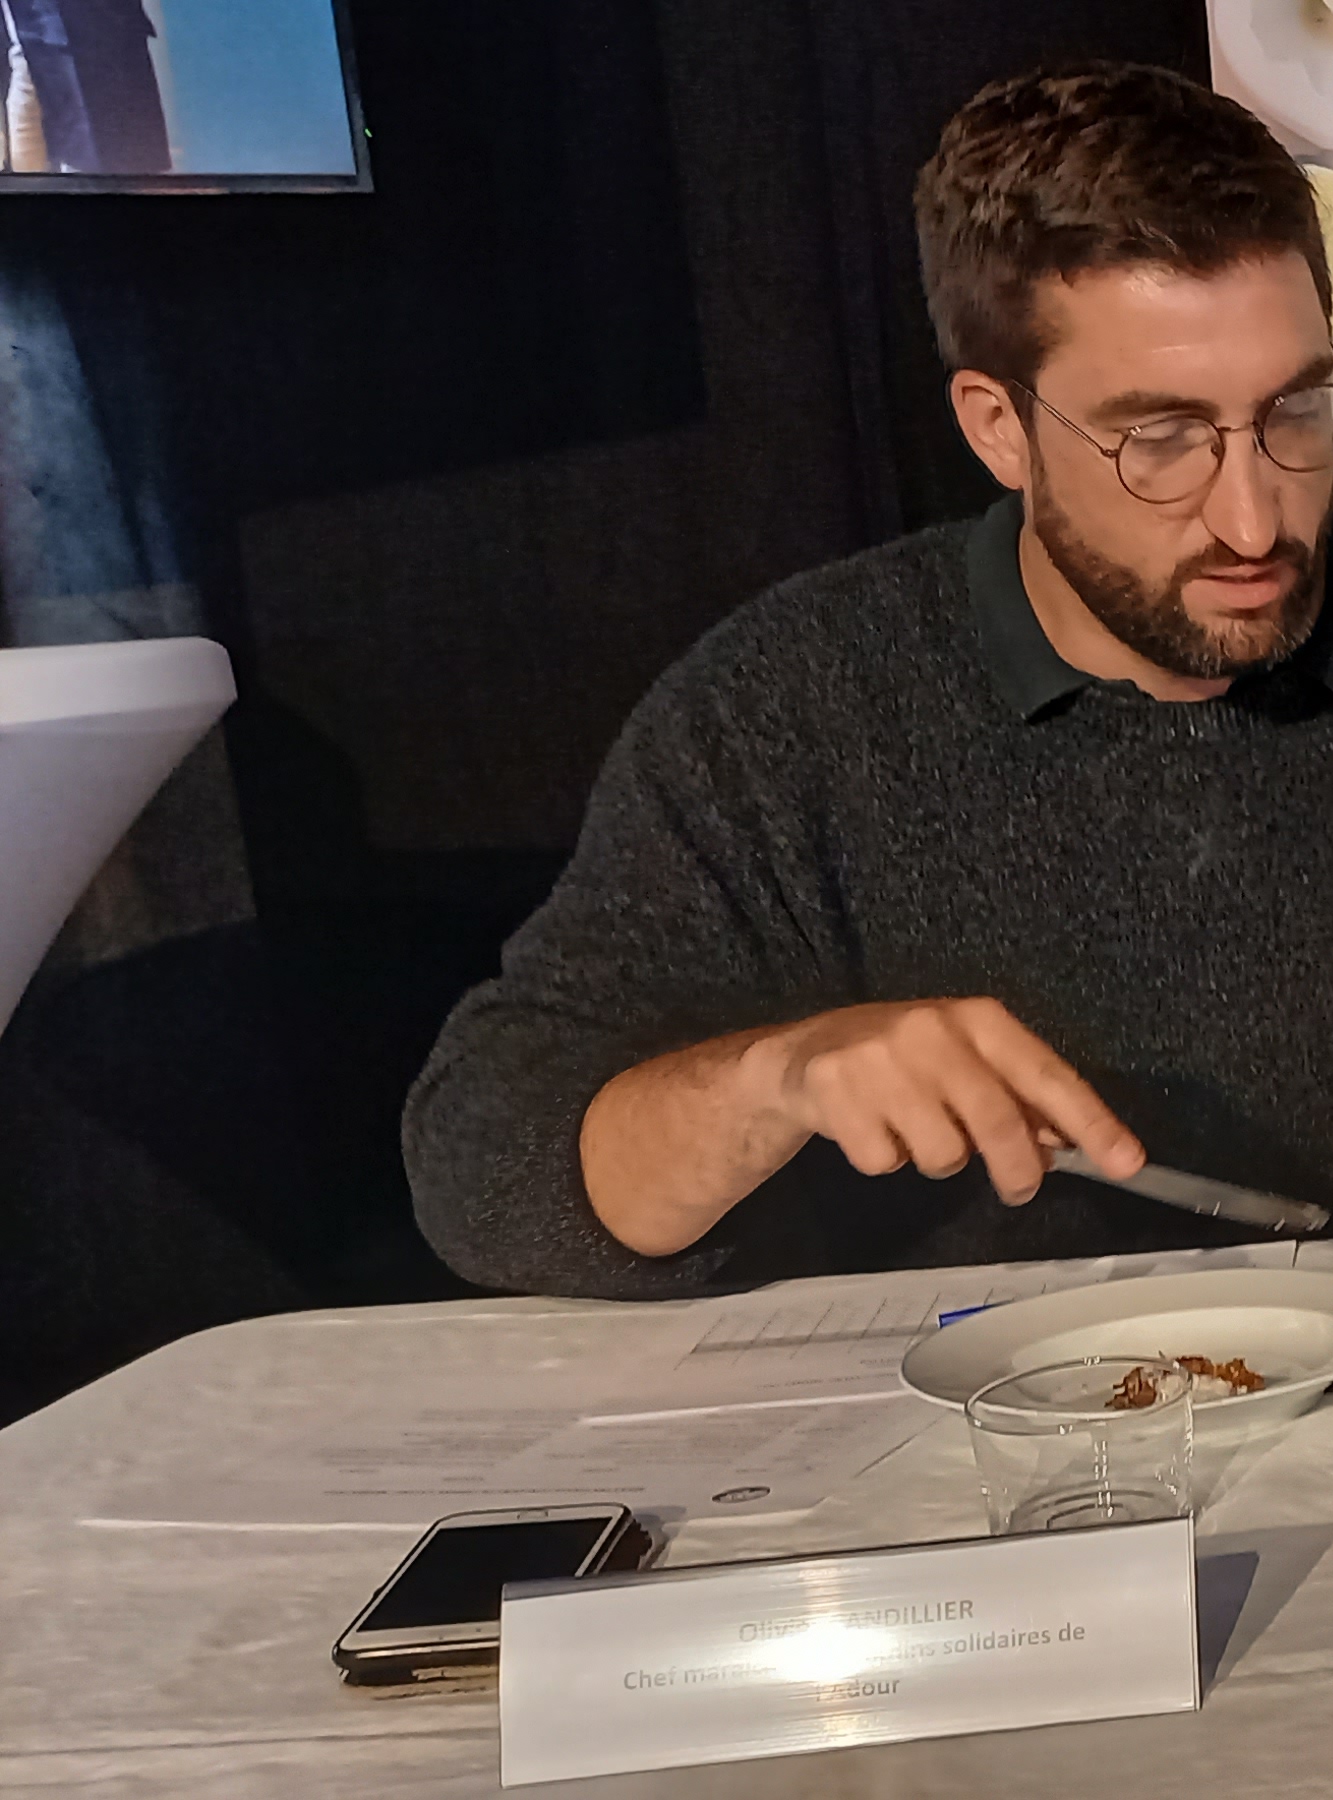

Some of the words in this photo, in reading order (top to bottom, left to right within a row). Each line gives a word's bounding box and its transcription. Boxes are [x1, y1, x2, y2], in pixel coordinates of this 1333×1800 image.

[845, 1598, 975, 1631] ANDILLIER
[623, 1665, 677, 1691] Chef
[942, 1617, 1052, 1655] solidaires
[1057, 1611, 1086, 1643] de
[815, 1677, 900, 1703] dour
